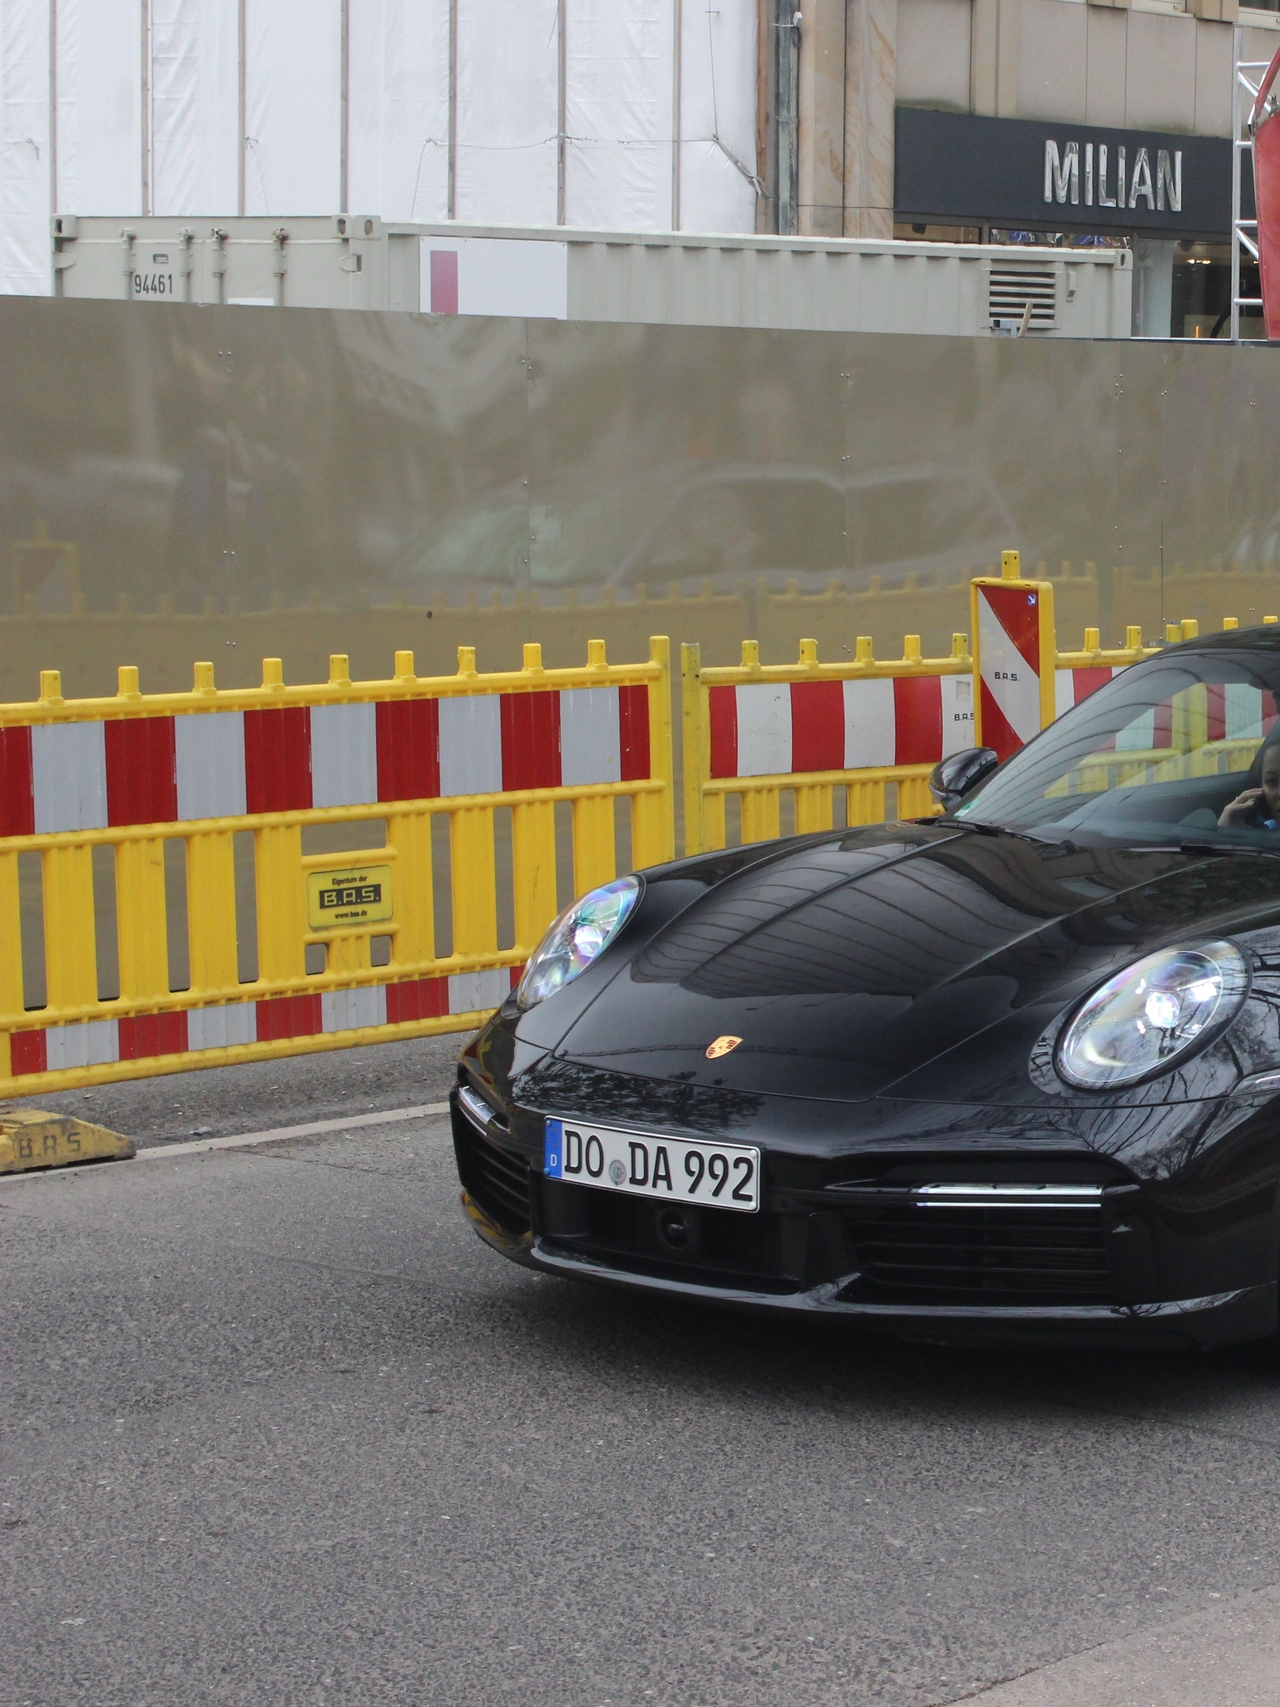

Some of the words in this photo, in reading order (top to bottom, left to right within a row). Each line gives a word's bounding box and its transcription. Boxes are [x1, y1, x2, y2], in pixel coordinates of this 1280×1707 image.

[1043, 139, 1183, 212] MILIAN
[134, 273, 173, 294] 94461
[332, 877, 358, 886] Eigentum
[324, 887, 379, 906] B.A.S.
[550, 1154, 558, 1167] D
[564, 1129, 605, 1178] DO
[628, 1141, 673, 1191] DA
[684, 1150, 755, 1203] 992
